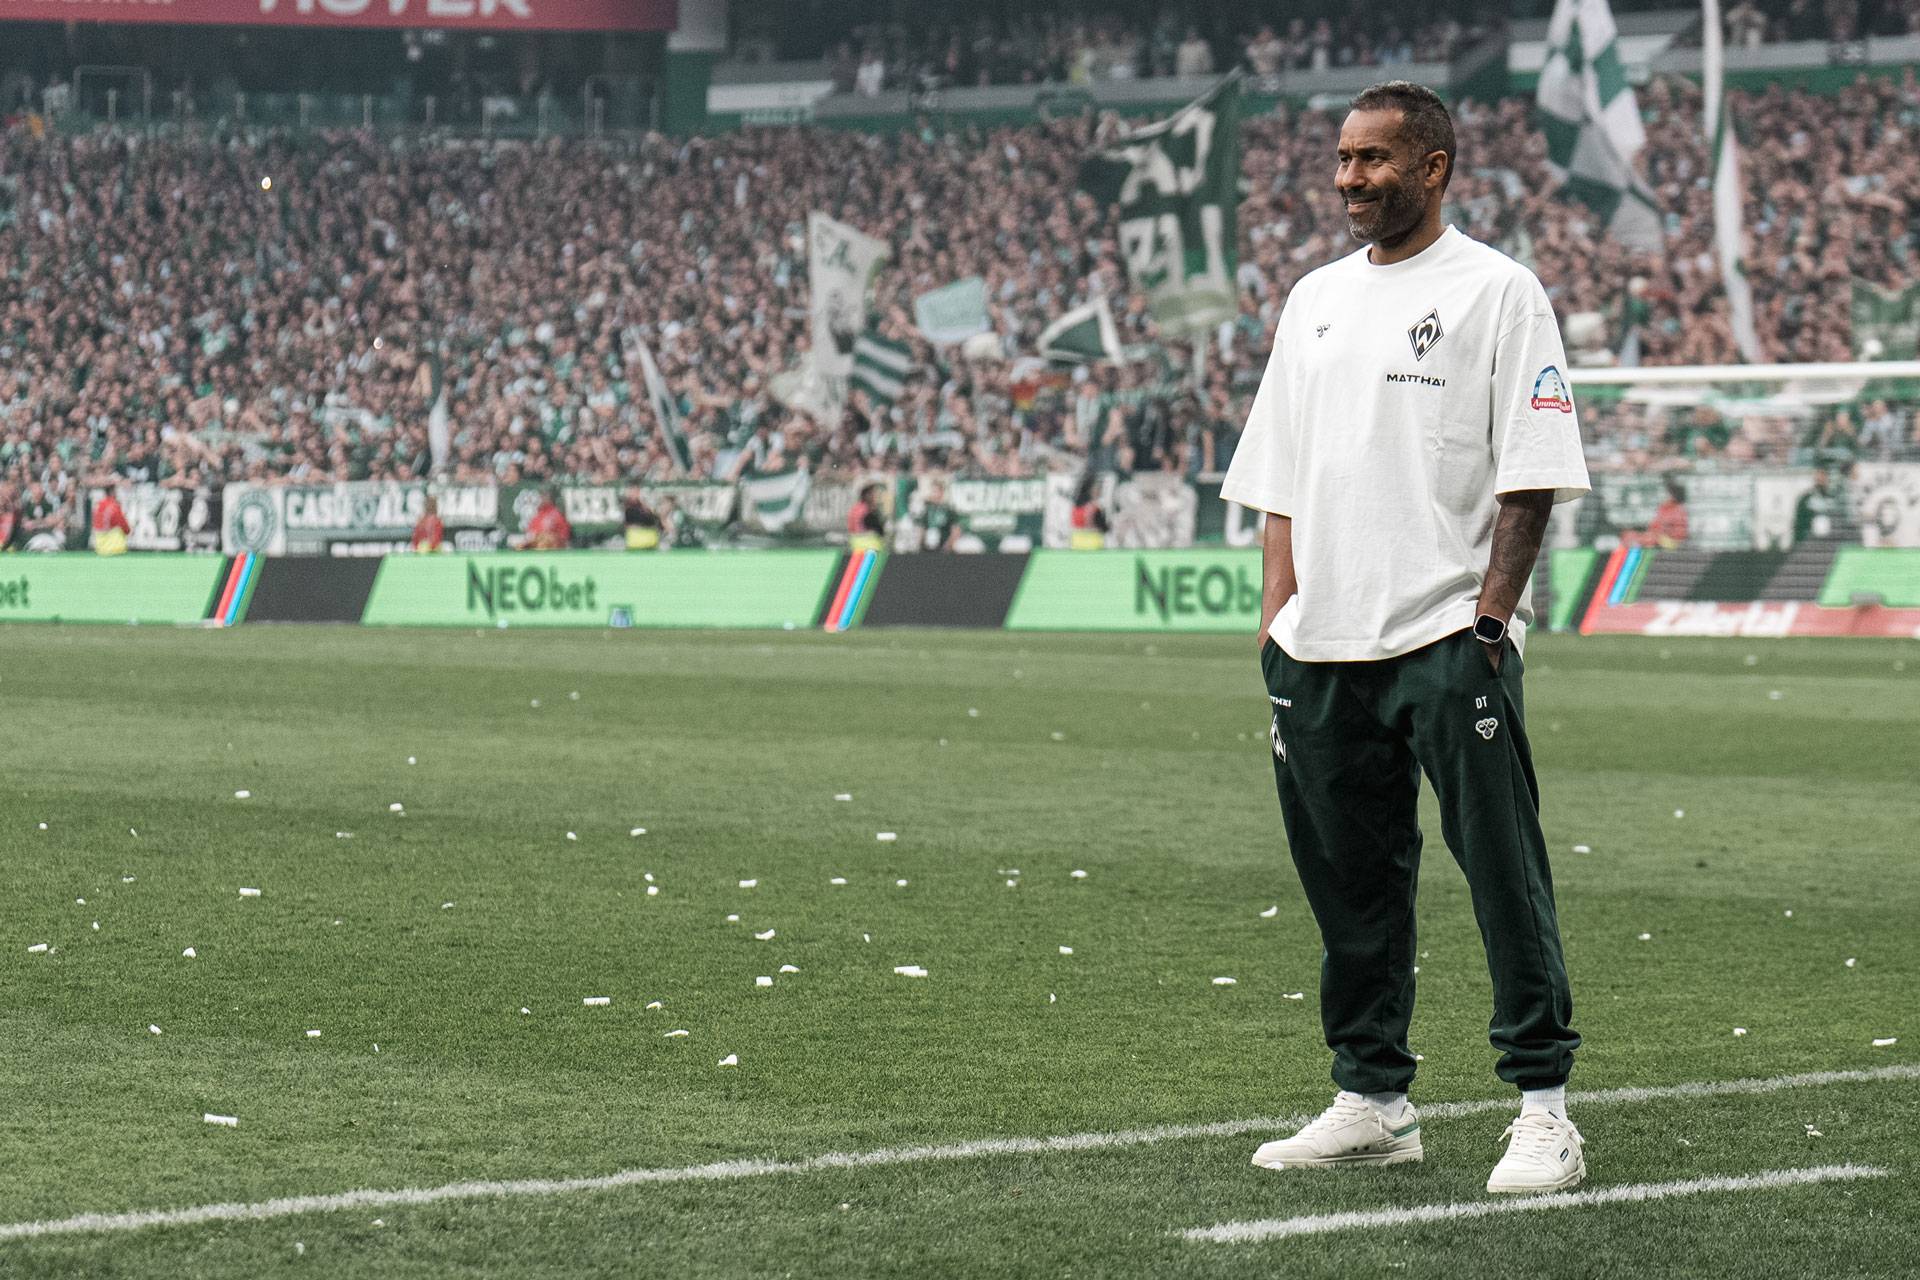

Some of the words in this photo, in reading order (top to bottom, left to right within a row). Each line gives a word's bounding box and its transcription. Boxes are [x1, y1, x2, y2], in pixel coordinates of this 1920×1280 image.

[1386, 374, 1446, 387] MATTHÄI
[466, 559, 598, 617] NEObet
[1134, 553, 1262, 621] NEOb
[1475, 695, 1487, 709] DT
